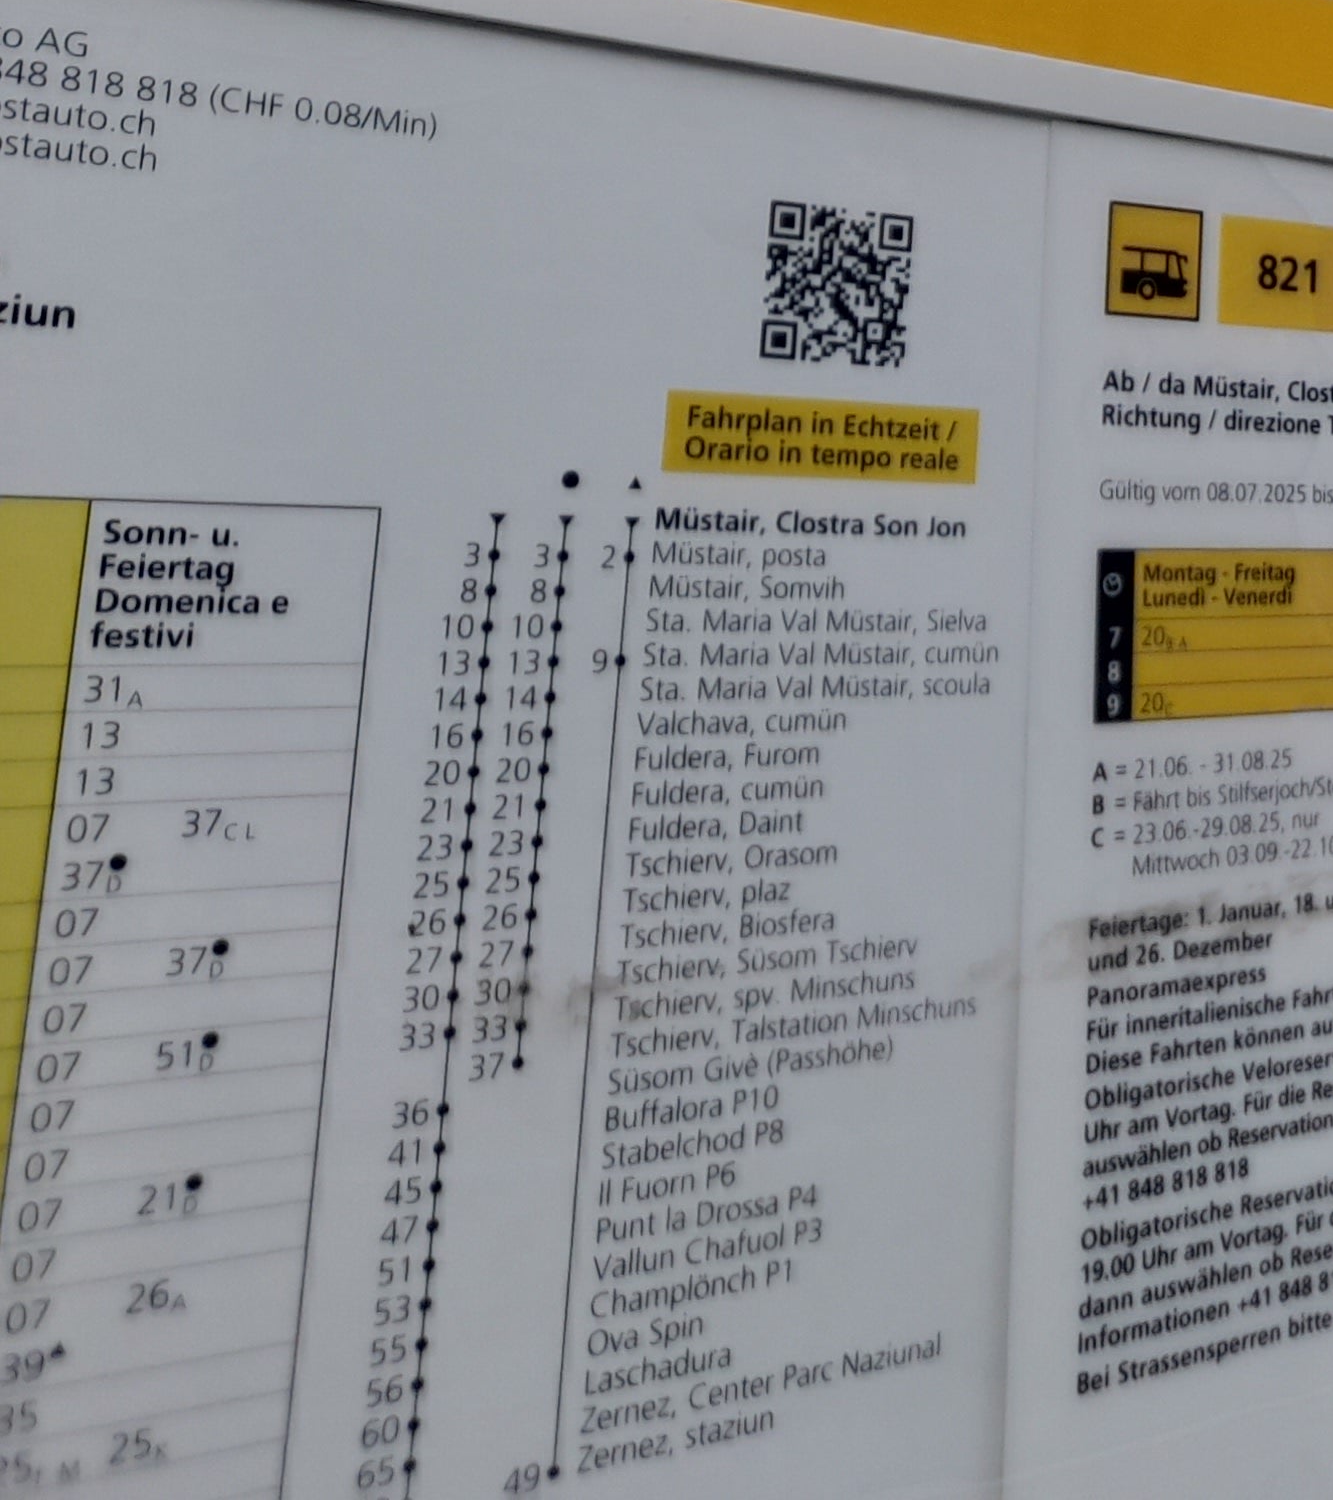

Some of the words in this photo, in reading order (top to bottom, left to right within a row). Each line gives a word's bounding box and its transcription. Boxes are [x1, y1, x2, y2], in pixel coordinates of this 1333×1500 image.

[35, 28, 88, 58] AG
[61, 65, 123, 96] 818
[137, 75, 197, 108] 818
[210, 84, 283, 118] (CHF
[1257, 254, 1321, 296] 821
[1103, 369, 1135, 393] Ab
[1159, 372, 1185, 396] da
[1194, 374, 1279, 404] Müstair,
[688, 404, 802, 440] Fahrplan
[812, 411, 834, 436] in
[844, 413, 940, 442] Echtzeit
[1102, 403, 1201, 436] Richtung
[1224, 408, 1321, 436] direzione
[685, 432, 770, 463] Orario
[779, 439, 802, 465] in
[811, 443, 891, 473] tempo
[900, 447, 959, 471] reale
[1100, 478, 1156, 507] Gültig
[1162, 485, 1200, 502] vom
[1207, 481, 1306, 504] 08.07.2025
[1312, 483, 1333, 505] bis
[104, 519, 198, 546] Sonn-
[212, 528, 238, 547] u.
[655, 507, 765, 536] Müstair,
[776, 510, 864, 536] Clostra
[874, 513, 918, 537] Son
[927, 516, 966, 538] Jon
[464, 542, 480, 567] 3
[652, 540, 751, 570] Müstair,
[762, 545, 826, 572] posta
[100, 553, 234, 589] Feiertag
[1143, 563, 1217, 588] Montag
[1235, 562, 1296, 587] Freitag
[95, 588, 259, 615] Domenica
[272, 595, 288, 615] e
[460, 578, 477, 602] 8
[649, 574, 748, 603] Müstair,
[760, 574, 844, 600] Somvih
[91, 620, 194, 649] festivi
[441, 613, 474, 639] 10
[646, 607, 690, 633] Sta.
[703, 608, 771, 634] Maria
[781, 607, 817, 634] Val
[826, 609, 916, 636] Müstair,
[928, 608, 986, 633] Sielva
[438, 650, 470, 676] 13
[643, 641, 687, 668] Sta.
[701, 642, 770, 668] Maria
[779, 641, 815, 666] Val
[824, 642, 915, 668] Müstair,
[925, 646, 998, 665] cumün
[434, 686, 467, 711] 14
[640, 675, 685, 703] Sta.
[698, 675, 767, 703] Maria
[776, 673, 812, 700] Val
[822, 675, 913, 701] Müstair,
[923, 672, 990, 696] scoula
[83, 722, 120, 750] 13
[431, 723, 464, 749] 16
[637, 710, 754, 738] Valchava,
[765, 708, 846, 734] cumün
[635, 743, 732, 772] Fuldera,
[745, 741, 819, 768] Furom
[78, 767, 115, 796] 13
[424, 760, 460, 786] 20
[632, 778, 729, 808] Fuldera,
[741, 776, 823, 802] cumün
[66, 813, 111, 843] 07
[629, 812, 727, 844] Fuldera,
[740, 810, 803, 837] Daint
[417, 835, 453, 861] 23
[626, 848, 732, 878] Tschierv,
[745, 844, 837, 871] Orasom
[1132, 846, 1220, 877] Mittwoch
[623, 883, 730, 914] Tschierv,
[741, 878, 791, 913] plaz
[55, 909, 100, 938] 07
[621, 919, 727, 949] Tschierv,
[740, 908, 835, 941] Biosfera
[1088, 945, 1128, 974] und
[1136, 942, 1164, 967] 26.
[1173, 929, 1272, 961] Dezember
[1088, 967, 1266, 1008] Panoramaexpress
[43, 1002, 88, 1034] 07
[30, 1100, 76, 1132] 07
[393, 1099, 429, 1128] 36
[605, 1096, 723, 1133] Buffalora
[733, 1084, 779, 1116] P10
[388, 1140, 422, 1165] 41
[602, 1122, 746, 1171] Stabelchod
[755, 1118, 784, 1147] P8
[381, 1216, 418, 1245] 47
[587, 1328, 639, 1357] Ova
[650, 1313, 704, 1349] Spin
[1077, 1364, 1110, 1396] Bei
[1118, 1325, 1281, 1385] Strassensperren
[1288, 1312, 1332, 1339] bitte
[585, 1347, 731, 1396] Laschadura
[577, 1433, 673, 1475] Zernez,
[686, 1410, 774, 1450] staziun
